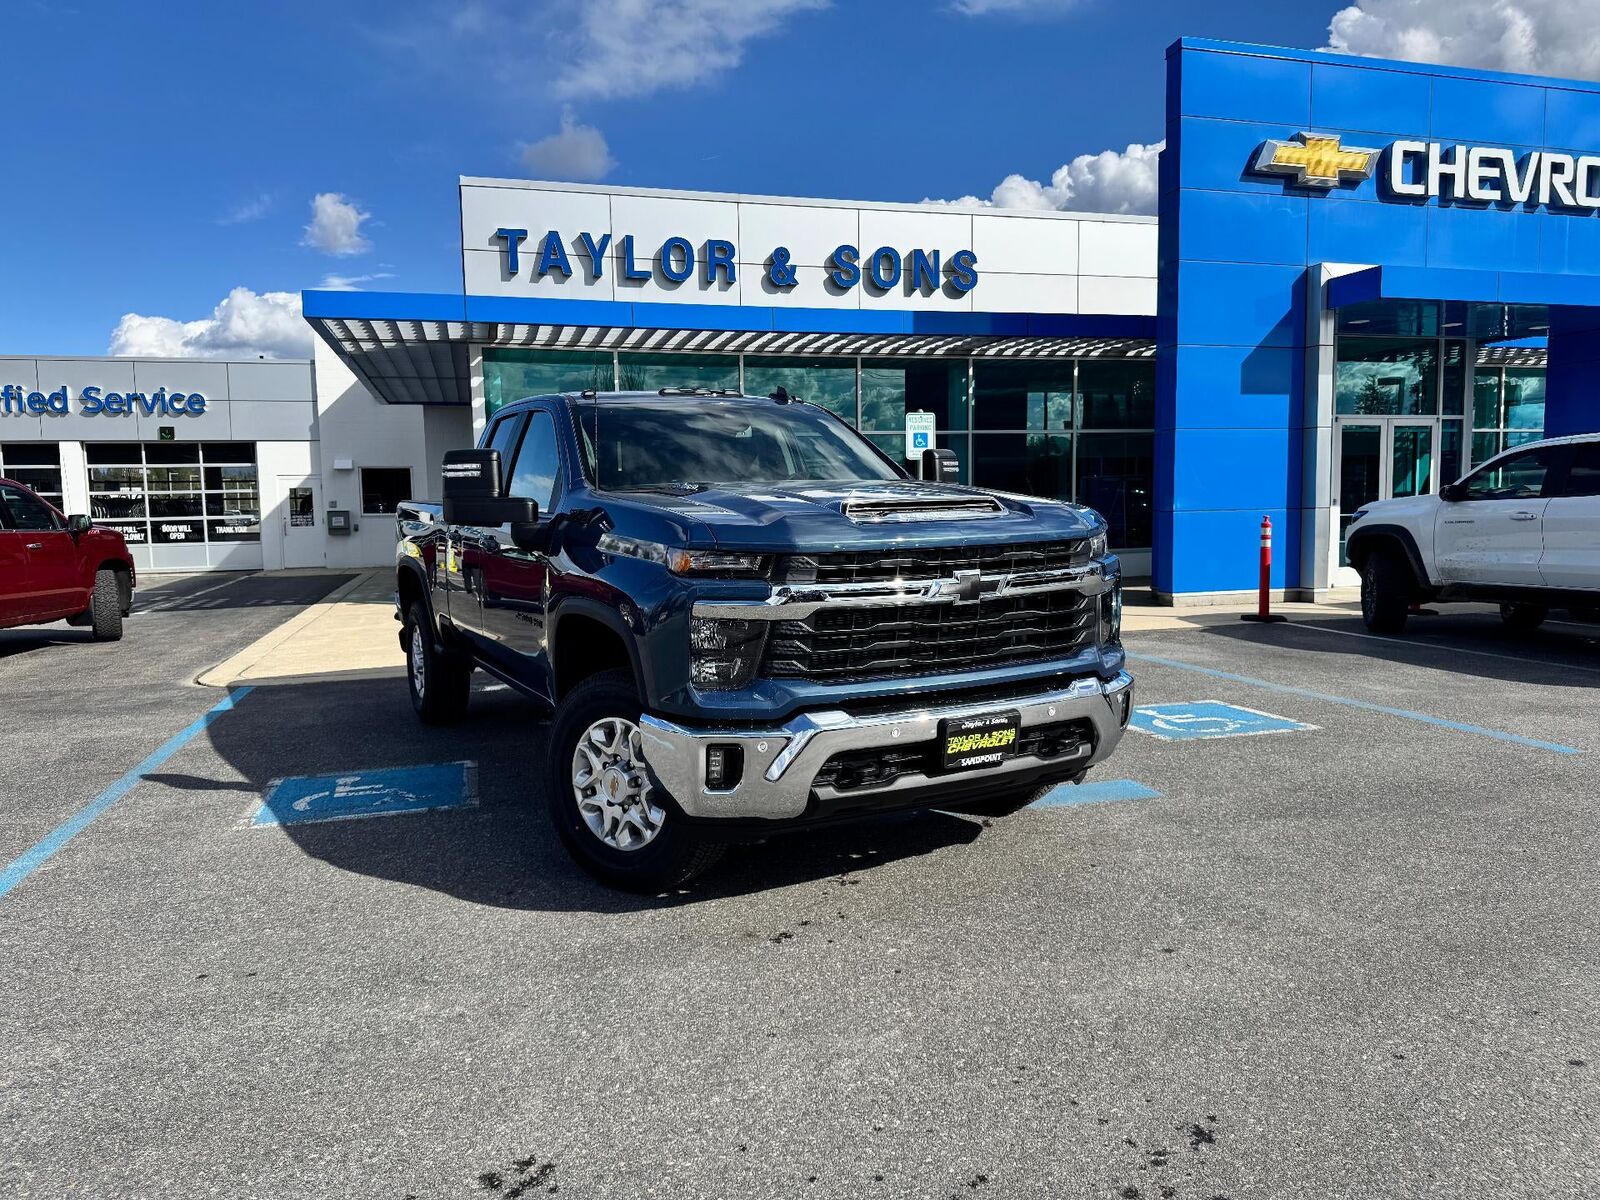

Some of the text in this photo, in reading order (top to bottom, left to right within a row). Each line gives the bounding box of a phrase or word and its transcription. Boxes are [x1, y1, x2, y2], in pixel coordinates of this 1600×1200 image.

[497, 227, 978, 292] TAYLOR & SONS
[1, 384, 206, 413] fied Service
[169, 532, 185, 540] OPEN
[215, 526, 234, 534] THANK
[948, 734, 981, 744] TAYLOR
[991, 728, 1015, 737] SONS
[947, 737, 1015, 753] CHEVROLET
[961, 753, 1002, 766] SANDPOINT
